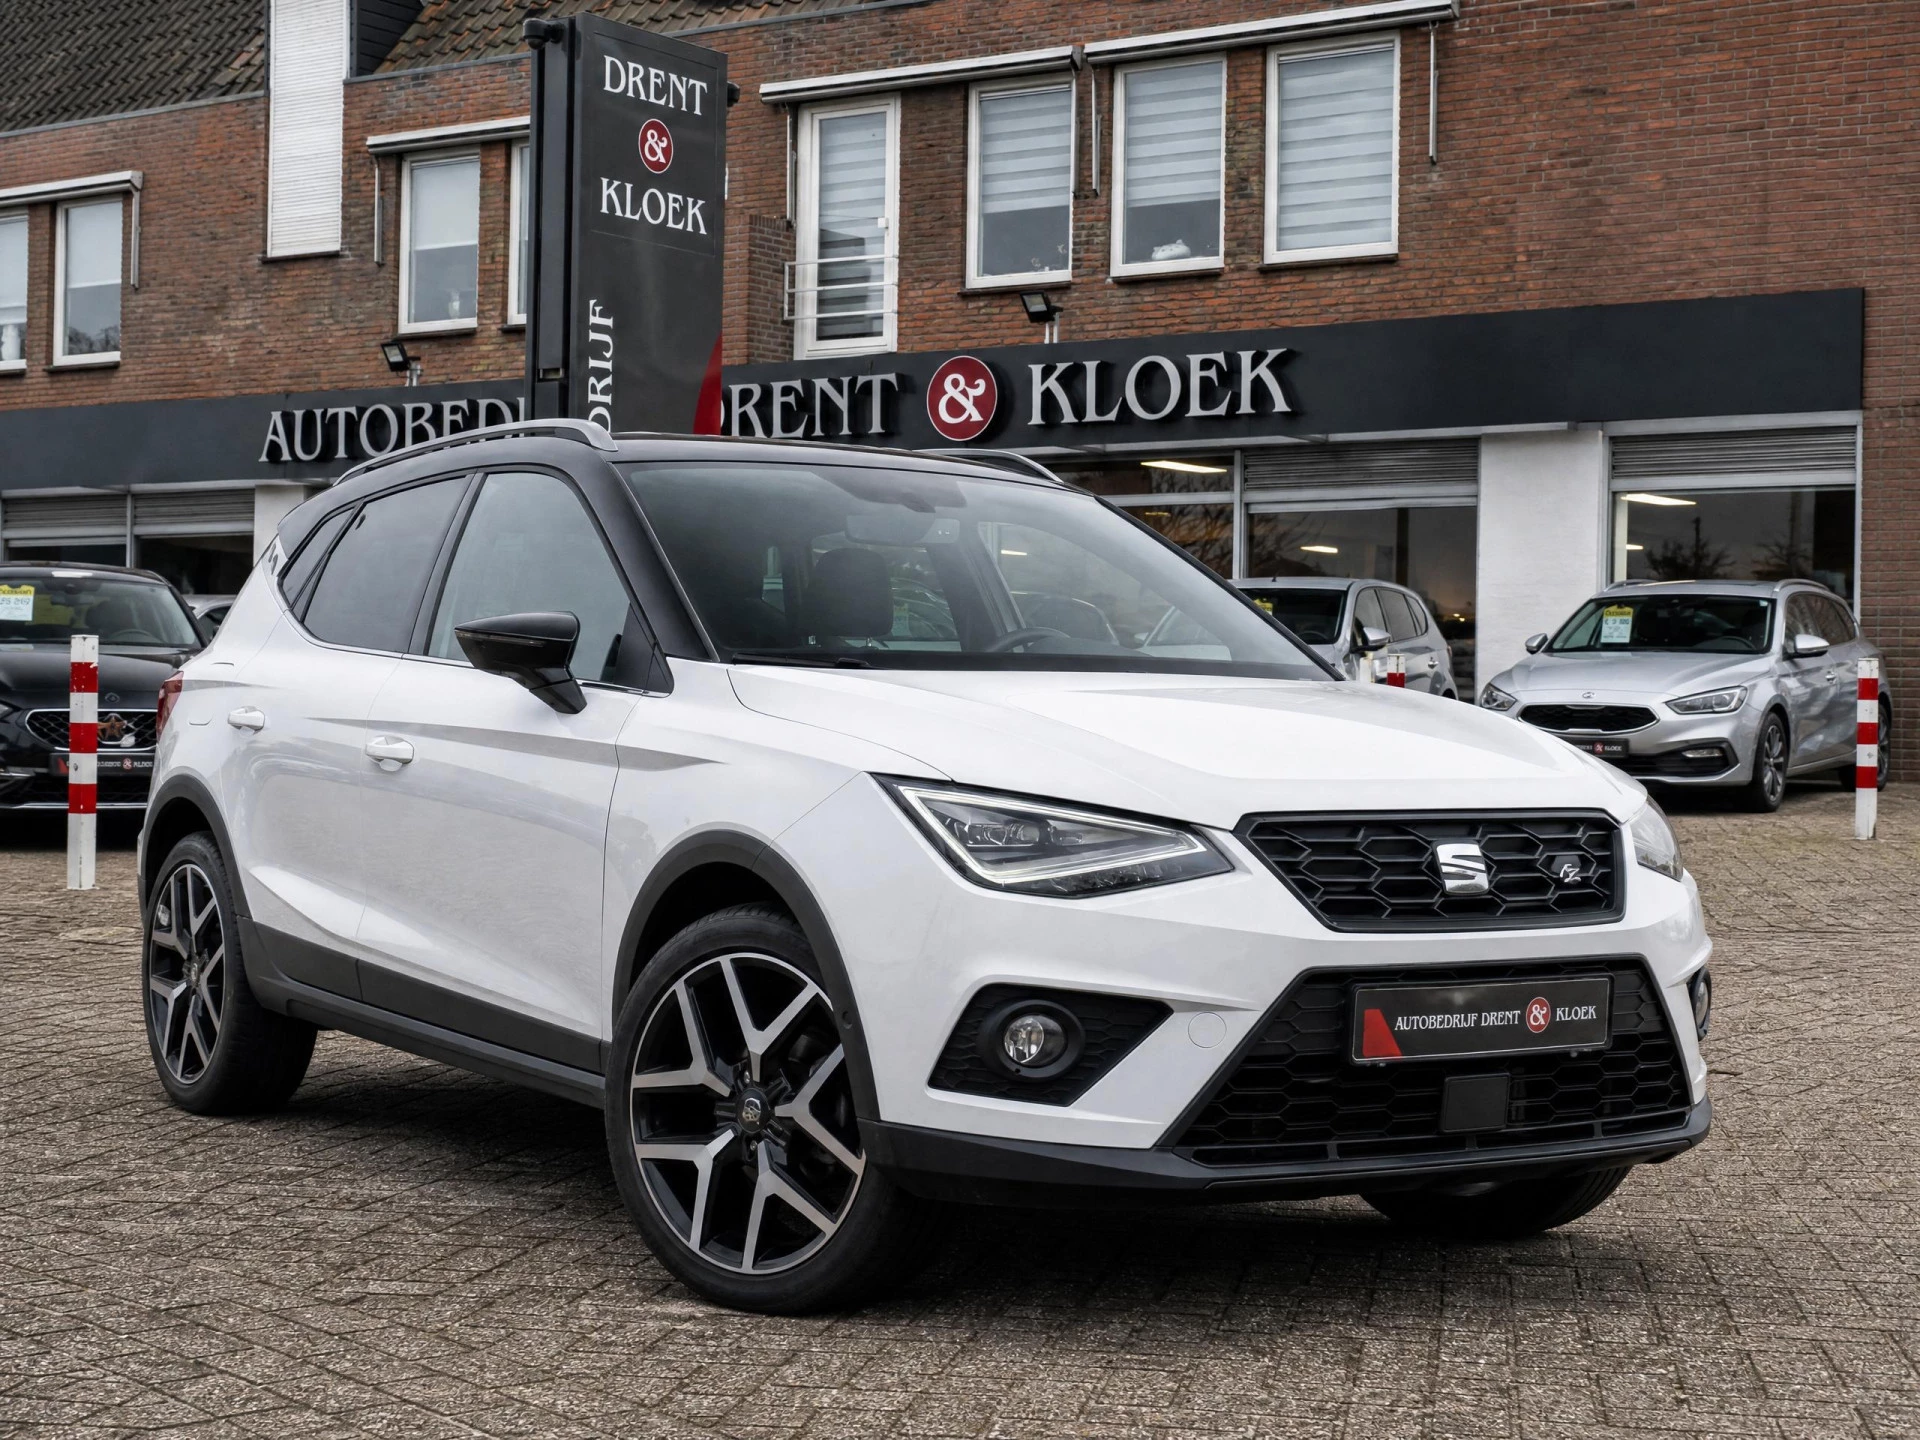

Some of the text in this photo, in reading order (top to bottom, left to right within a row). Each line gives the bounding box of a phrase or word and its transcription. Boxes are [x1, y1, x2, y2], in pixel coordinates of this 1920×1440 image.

[603, 54, 708, 116] DRENT
[644, 129, 668, 164] &
[600, 176, 708, 235] KLOEK
[258, 348, 1292, 463] AUTOBED RENT & KLOEK
[1394, 1013, 1478, 1031] AUTOBEDRIJF
[1480, 1010, 1521, 1027] DRENT
[1555, 1005, 1597, 1022] KLOEK
